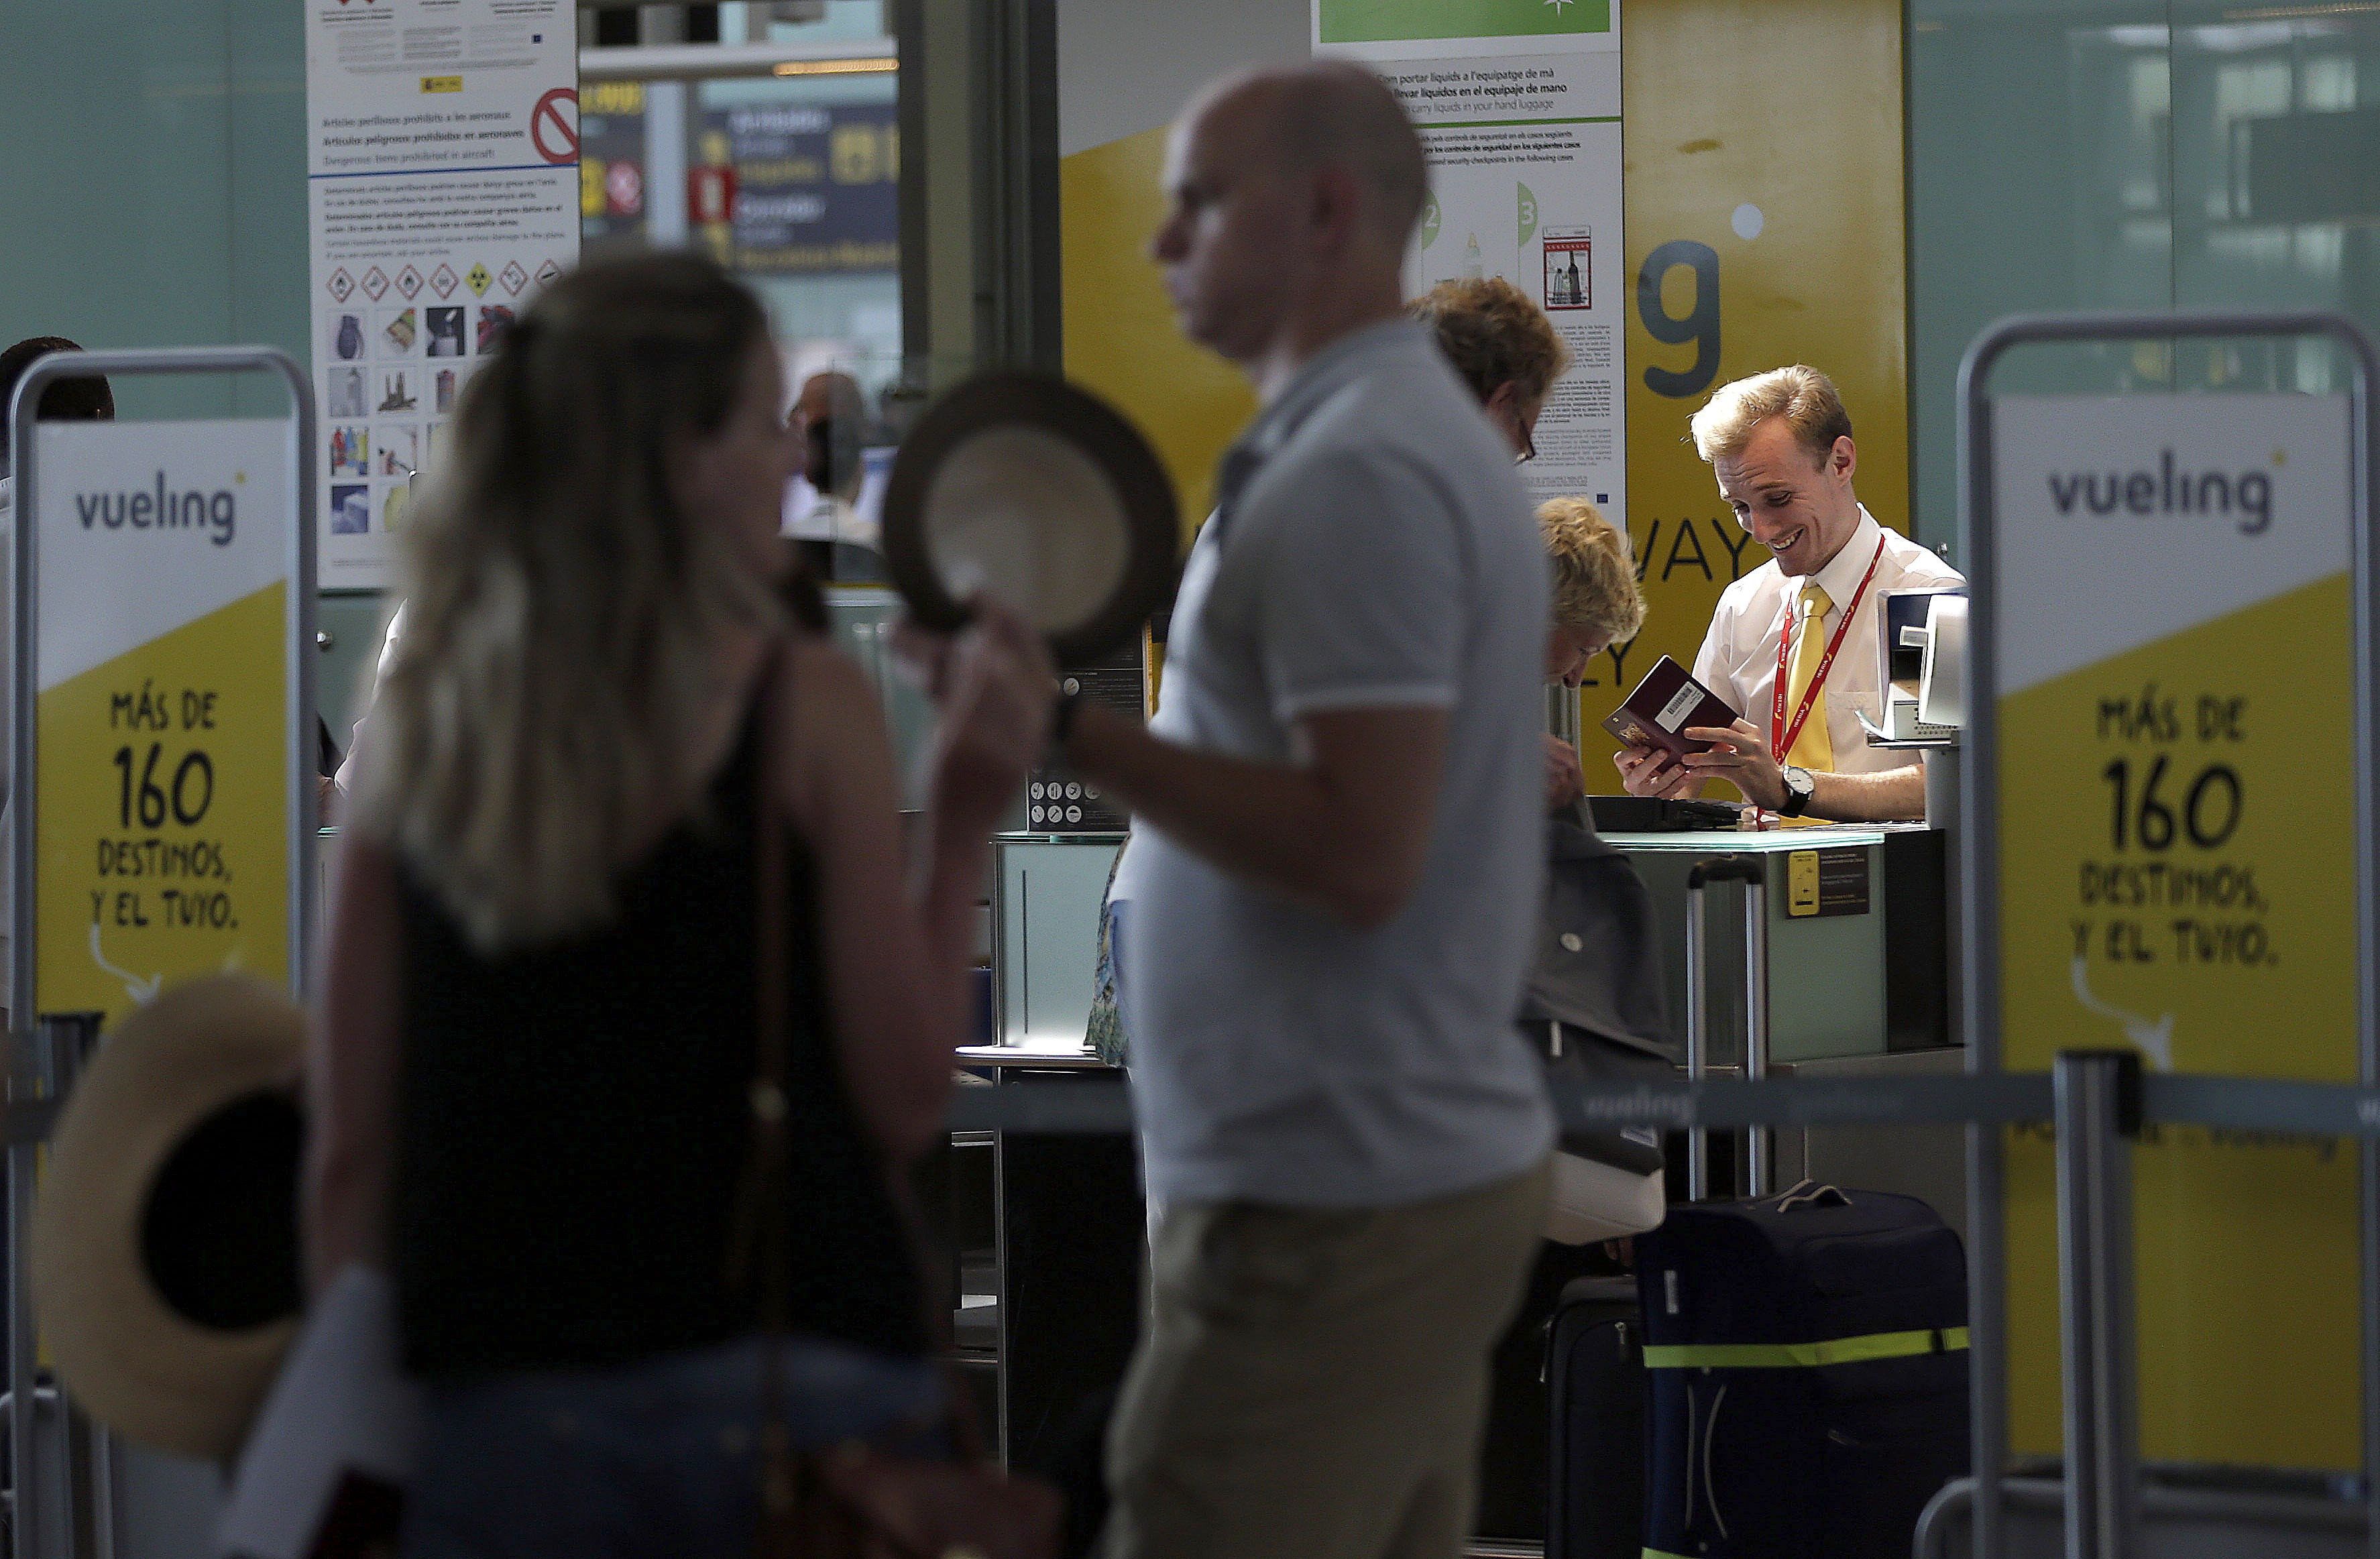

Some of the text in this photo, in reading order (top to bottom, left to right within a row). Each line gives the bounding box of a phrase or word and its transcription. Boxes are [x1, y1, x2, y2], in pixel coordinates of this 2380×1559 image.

[1400, 74, 1428, 85] portar
[1463, 72, 1469, 80] a
[1525, 68, 1537, 78] de
[1460, 87, 1471, 97] en
[1473, 85, 1482, 96] el
[1484, 83, 1524, 97] equipaje
[1526, 83, 1538, 94] de
[1540, 83, 1568, 94] mano
[1434, 101, 1461, 113] liquids
[1473, 102, 1493, 114] your
[1494, 99, 1517, 111] hand
[1519, 99, 1554, 112] luggage
[1424, 204, 1440, 229] 2
[1521, 201, 1536, 226] 3
[74, 469, 235, 546] vueling
[2049, 448, 2272, 535] vueling
[110, 678, 219, 731] MÁS DE
[2096, 684, 2247, 741] MÁS DE
[113, 742, 214, 829] 160
[2103, 754, 2243, 853] 160
[97, 838, 233, 883] DESTINOS,
[90, 890, 106, 925] Y
[115, 890, 149, 928] EL
[2072, 919, 2091, 956] Y
[2106, 920, 2155, 964] EL
